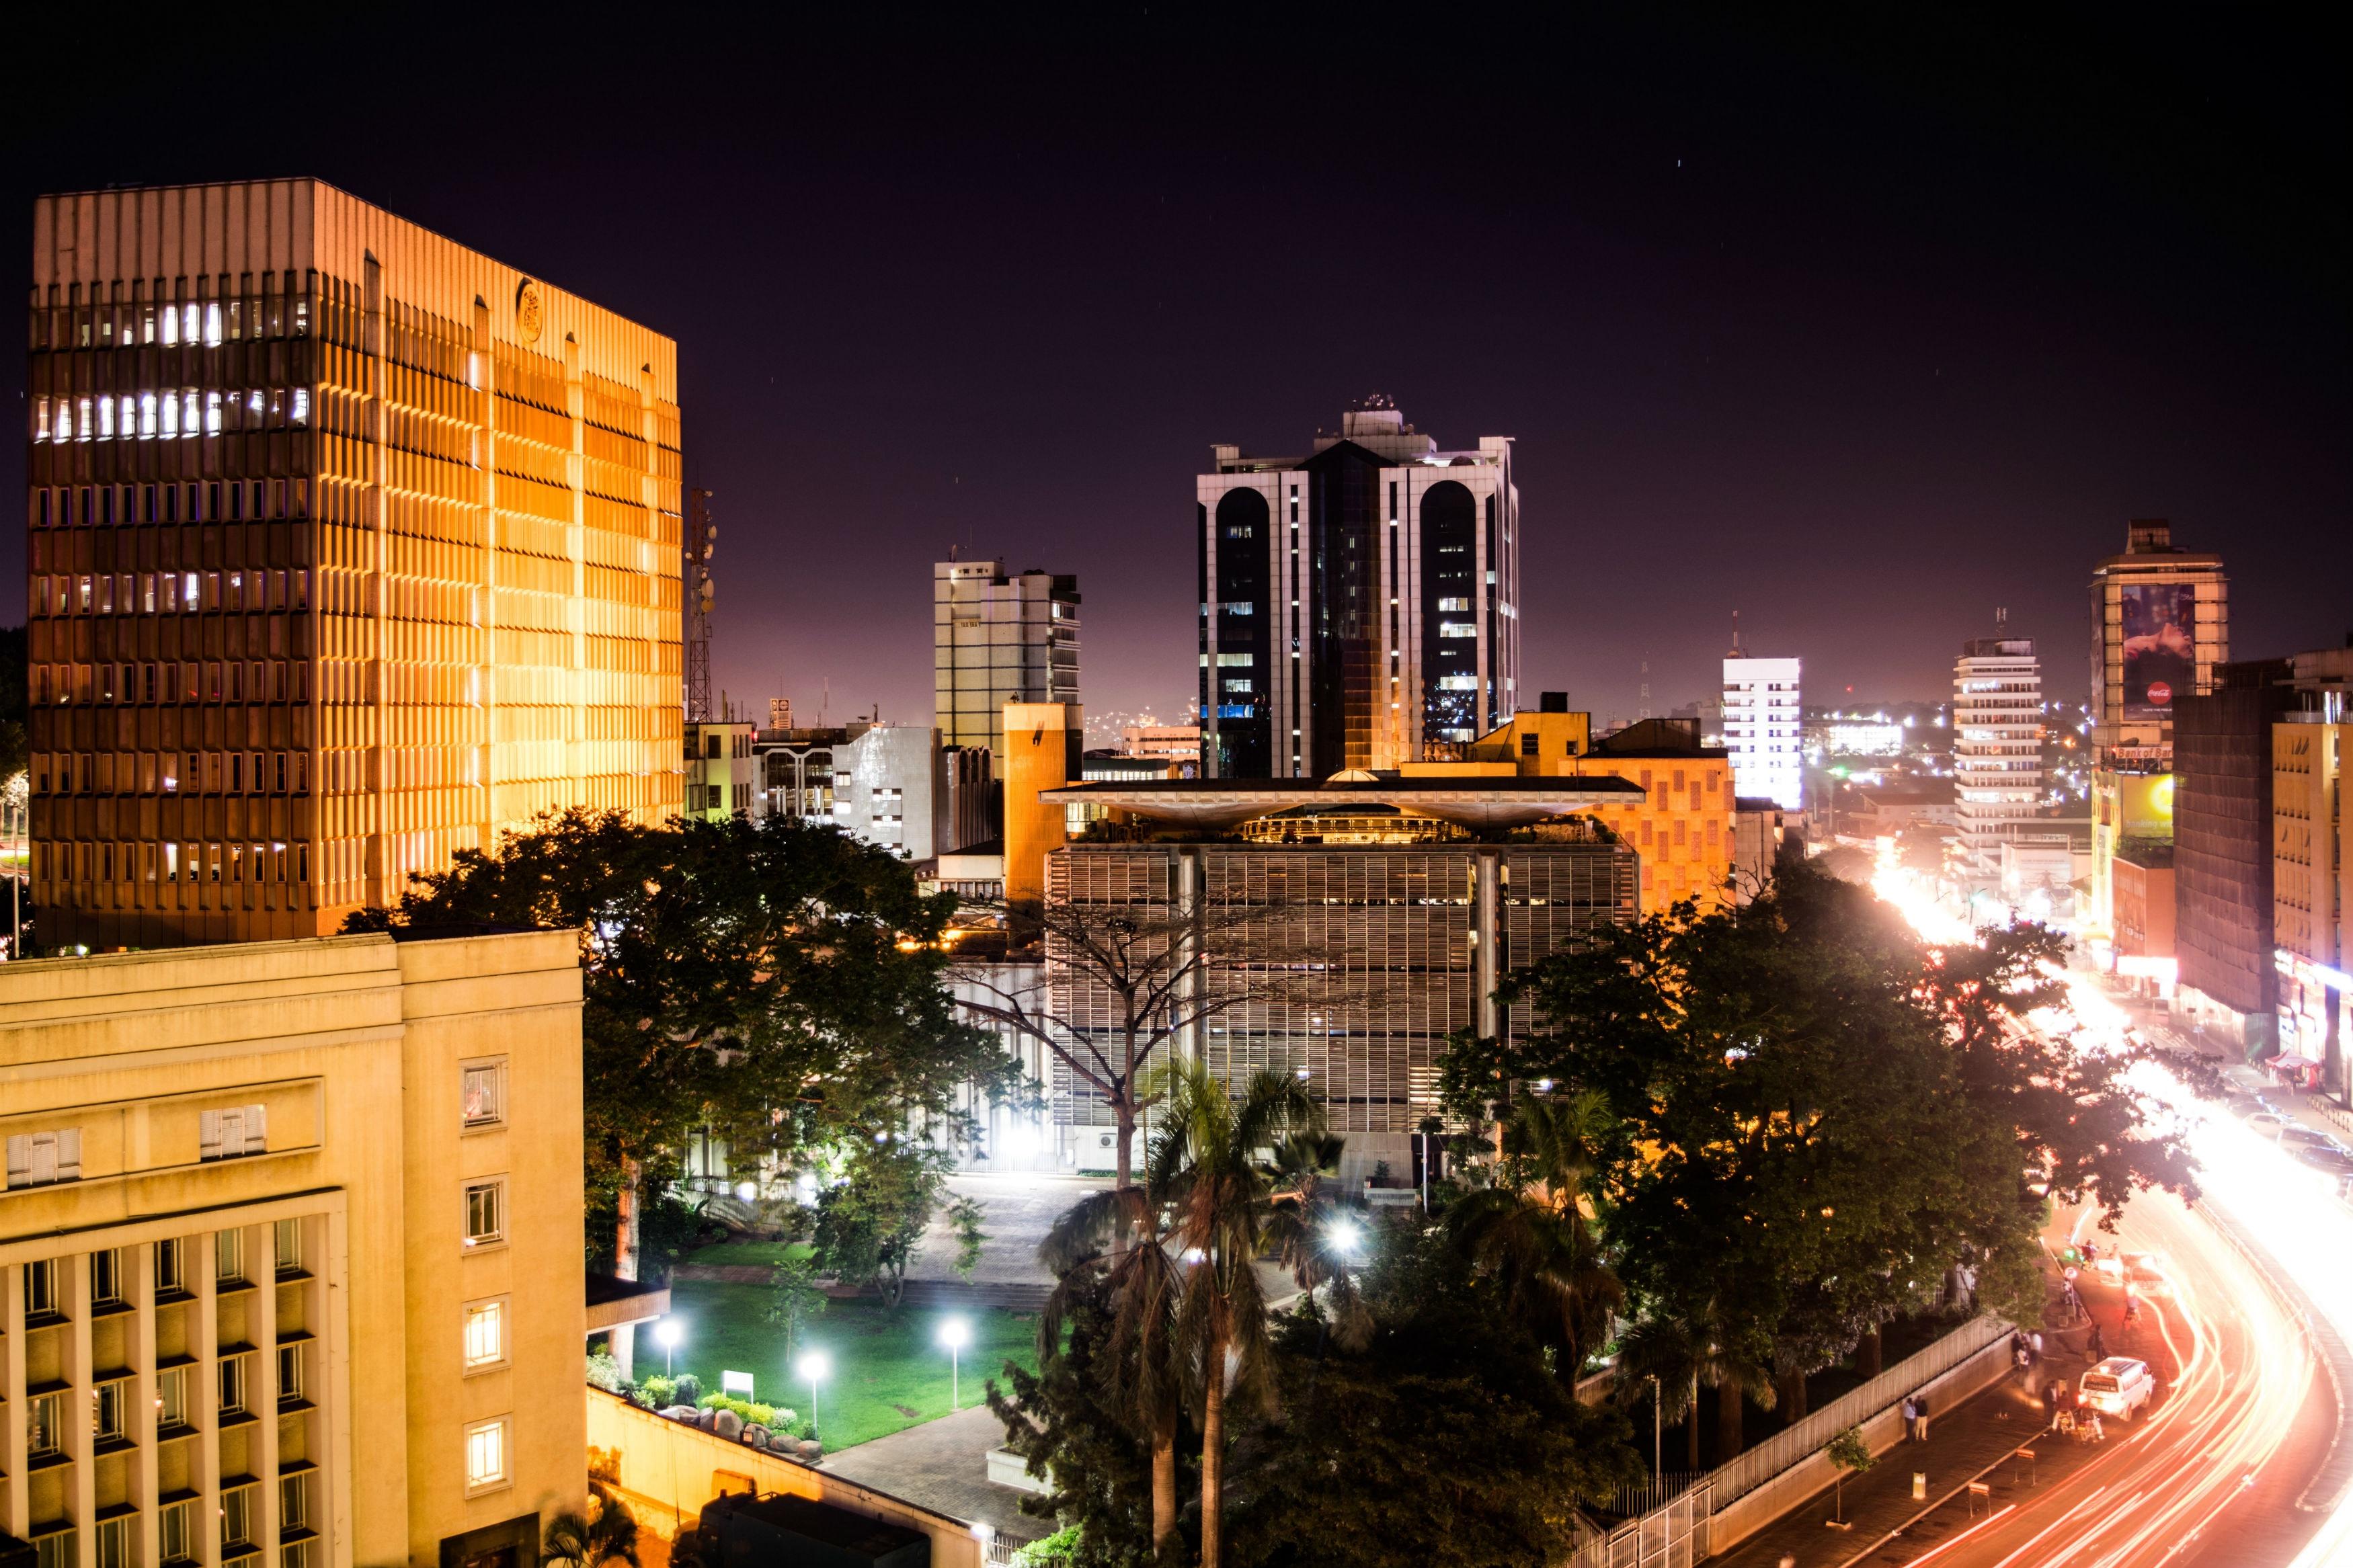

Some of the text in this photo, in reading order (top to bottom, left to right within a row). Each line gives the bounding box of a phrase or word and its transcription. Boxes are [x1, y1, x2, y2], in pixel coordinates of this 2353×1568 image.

[2118, 748, 2172, 757] Bank of Bar
[2126, 819, 2157, 829] banking
